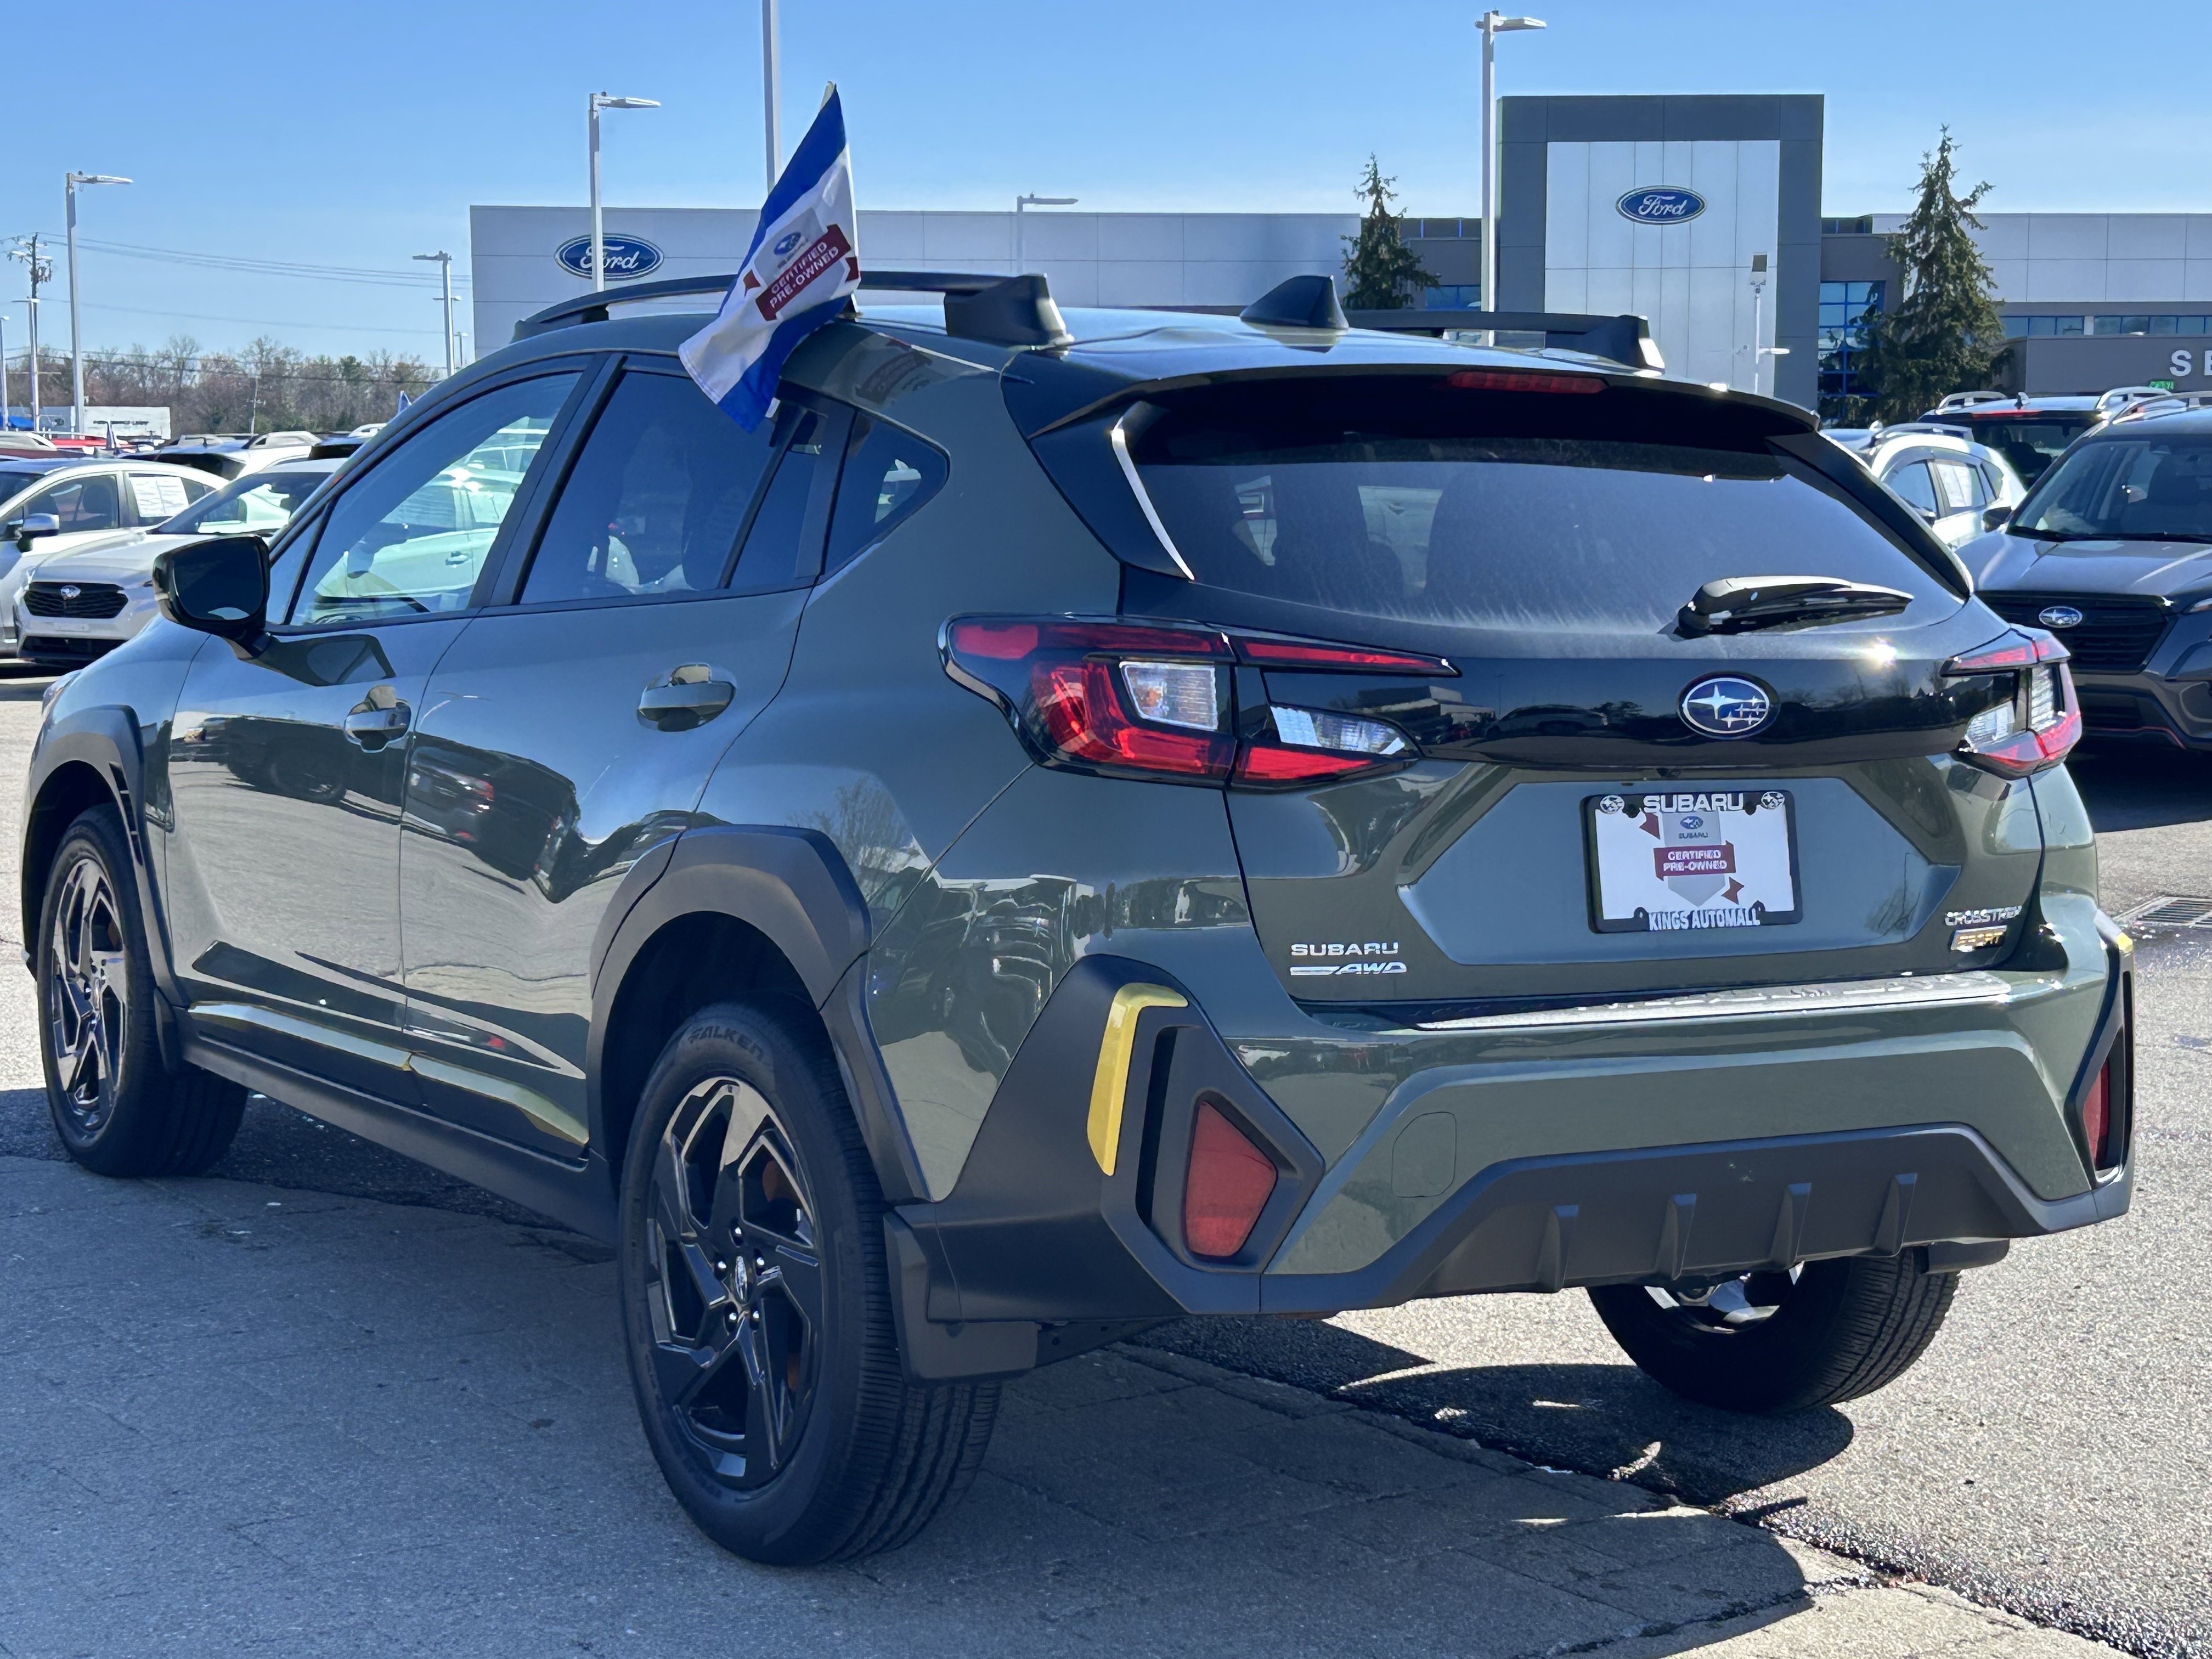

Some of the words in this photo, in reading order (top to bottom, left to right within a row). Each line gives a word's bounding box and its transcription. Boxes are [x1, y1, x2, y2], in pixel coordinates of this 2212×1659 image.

[1638, 195, 1688, 215] Ford
[1643, 793, 1745, 813] SUBARU
[1667, 849, 1722, 861] CERTIFIED
[1663, 860, 1728, 872] PRE-OWNED
[1647, 911, 1689, 931] KINGS
[1691, 907, 1760, 929] AUTOMALL
[1290, 941, 1399, 956] SUBARU
[1335, 961, 1407, 975] AWD
[687, 1025, 764, 1062] FALKEN
